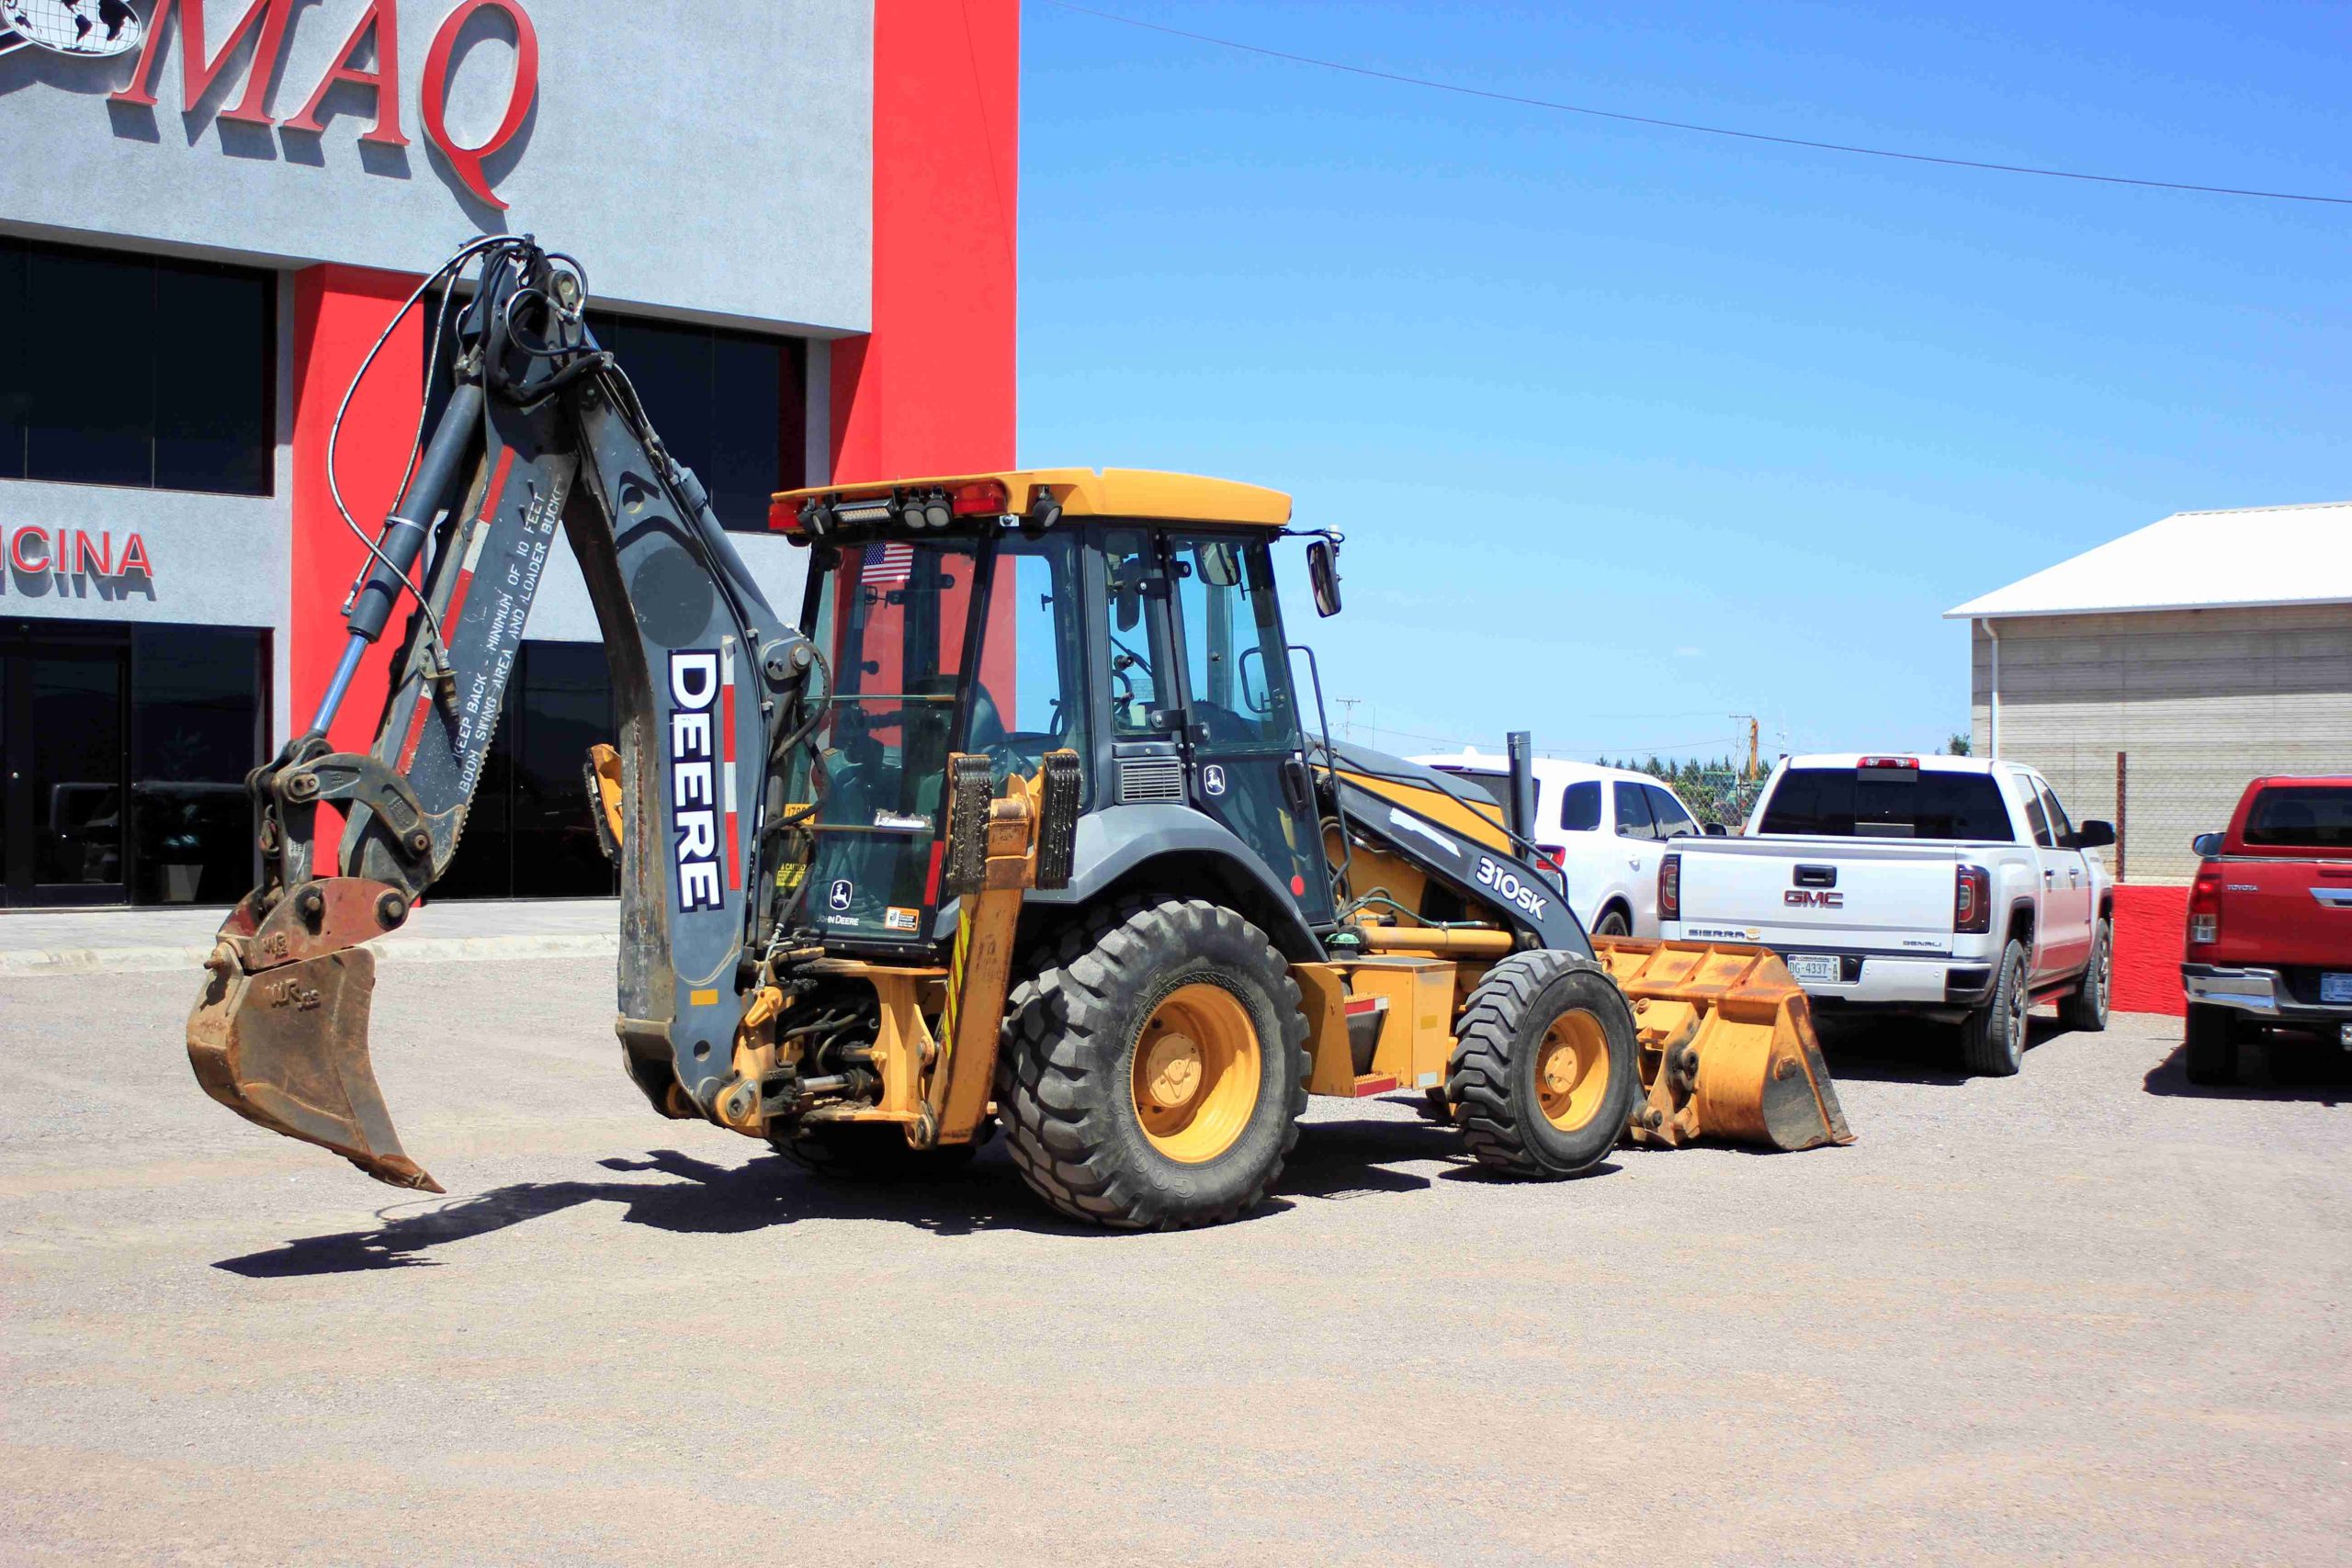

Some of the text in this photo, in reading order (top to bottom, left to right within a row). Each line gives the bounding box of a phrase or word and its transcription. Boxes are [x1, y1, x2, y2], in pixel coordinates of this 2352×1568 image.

[452, 716, 472, 759] KEEP
[466, 672, 488, 714] BACK
[486, 592, 514, 651] MINIMUM
[507, 563, 521, 586] OF
[516, 540, 530, 557] 10
[524, 491, 545, 535] FEET
[458, 749, 481, 794] BOOM
[492, 649, 514, 689] AREA
[507, 607, 526, 640] AND
[519, 541, 548, 604] LOADER
[669, 649, 724, 913] DEERE
[1476, 856, 1550, 922] 310SK
[2226, 884, 2259, 892] TOYOTA
[1784, 890, 1844, 908] GMC
[816, 913, 860, 927] JOHN DEERE
[1688, 928, 1746, 939] SIERRA
[1789, 962, 1838, 976] DG-4337-A
